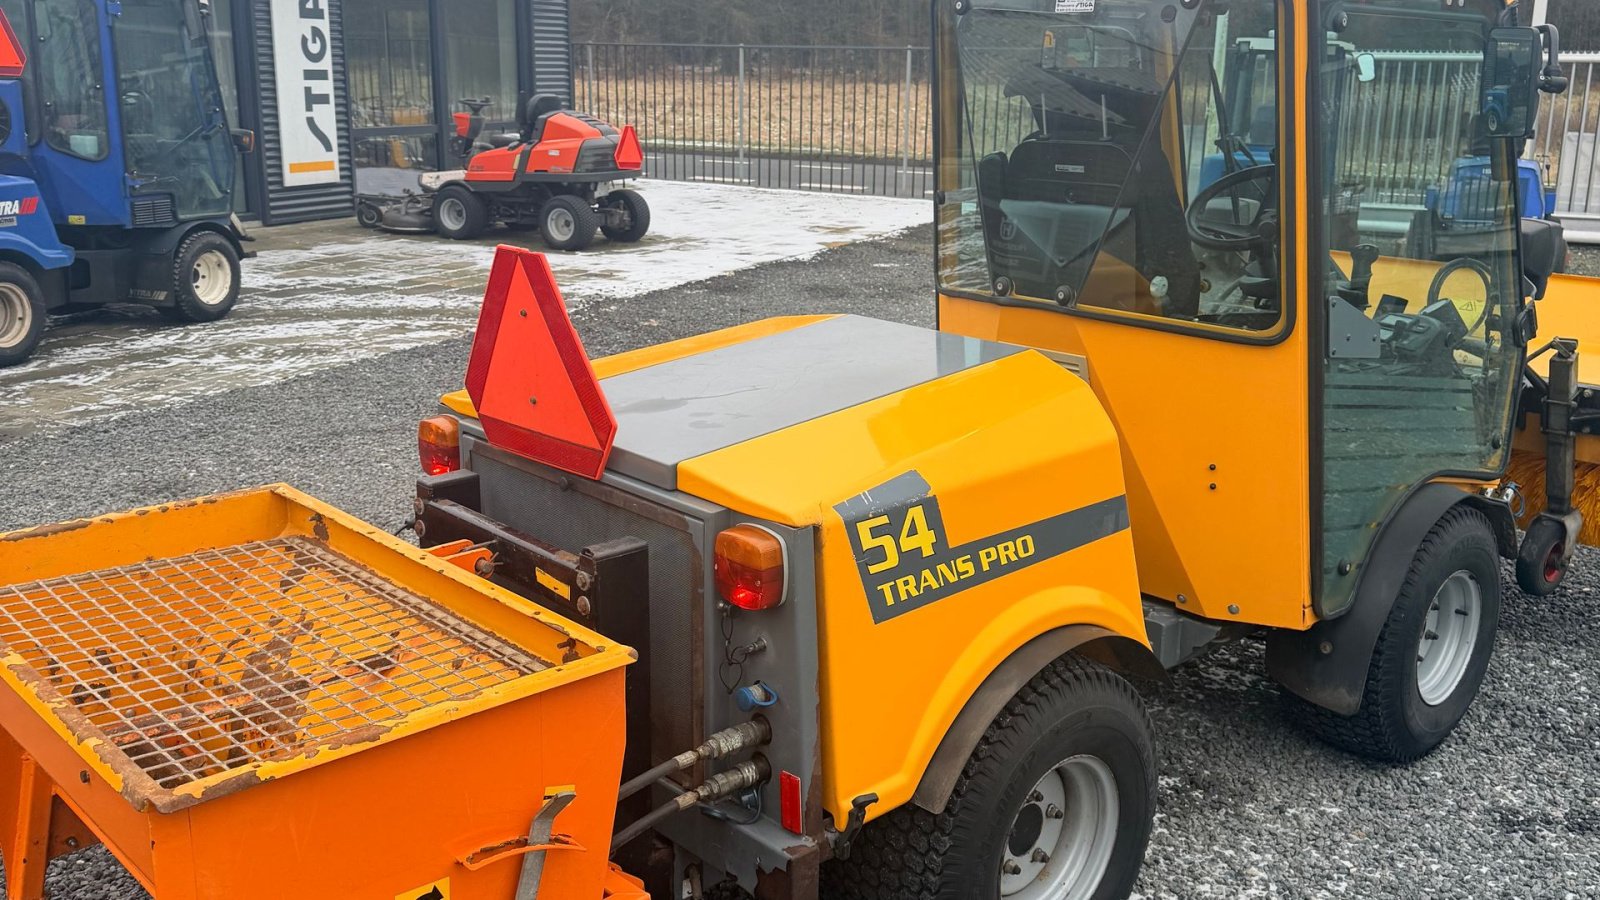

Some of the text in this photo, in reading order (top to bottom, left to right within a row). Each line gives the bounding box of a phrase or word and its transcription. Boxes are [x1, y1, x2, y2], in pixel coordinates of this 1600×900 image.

[856, 505, 937, 575] 54
[877, 534, 1036, 607] TRANS PRO
